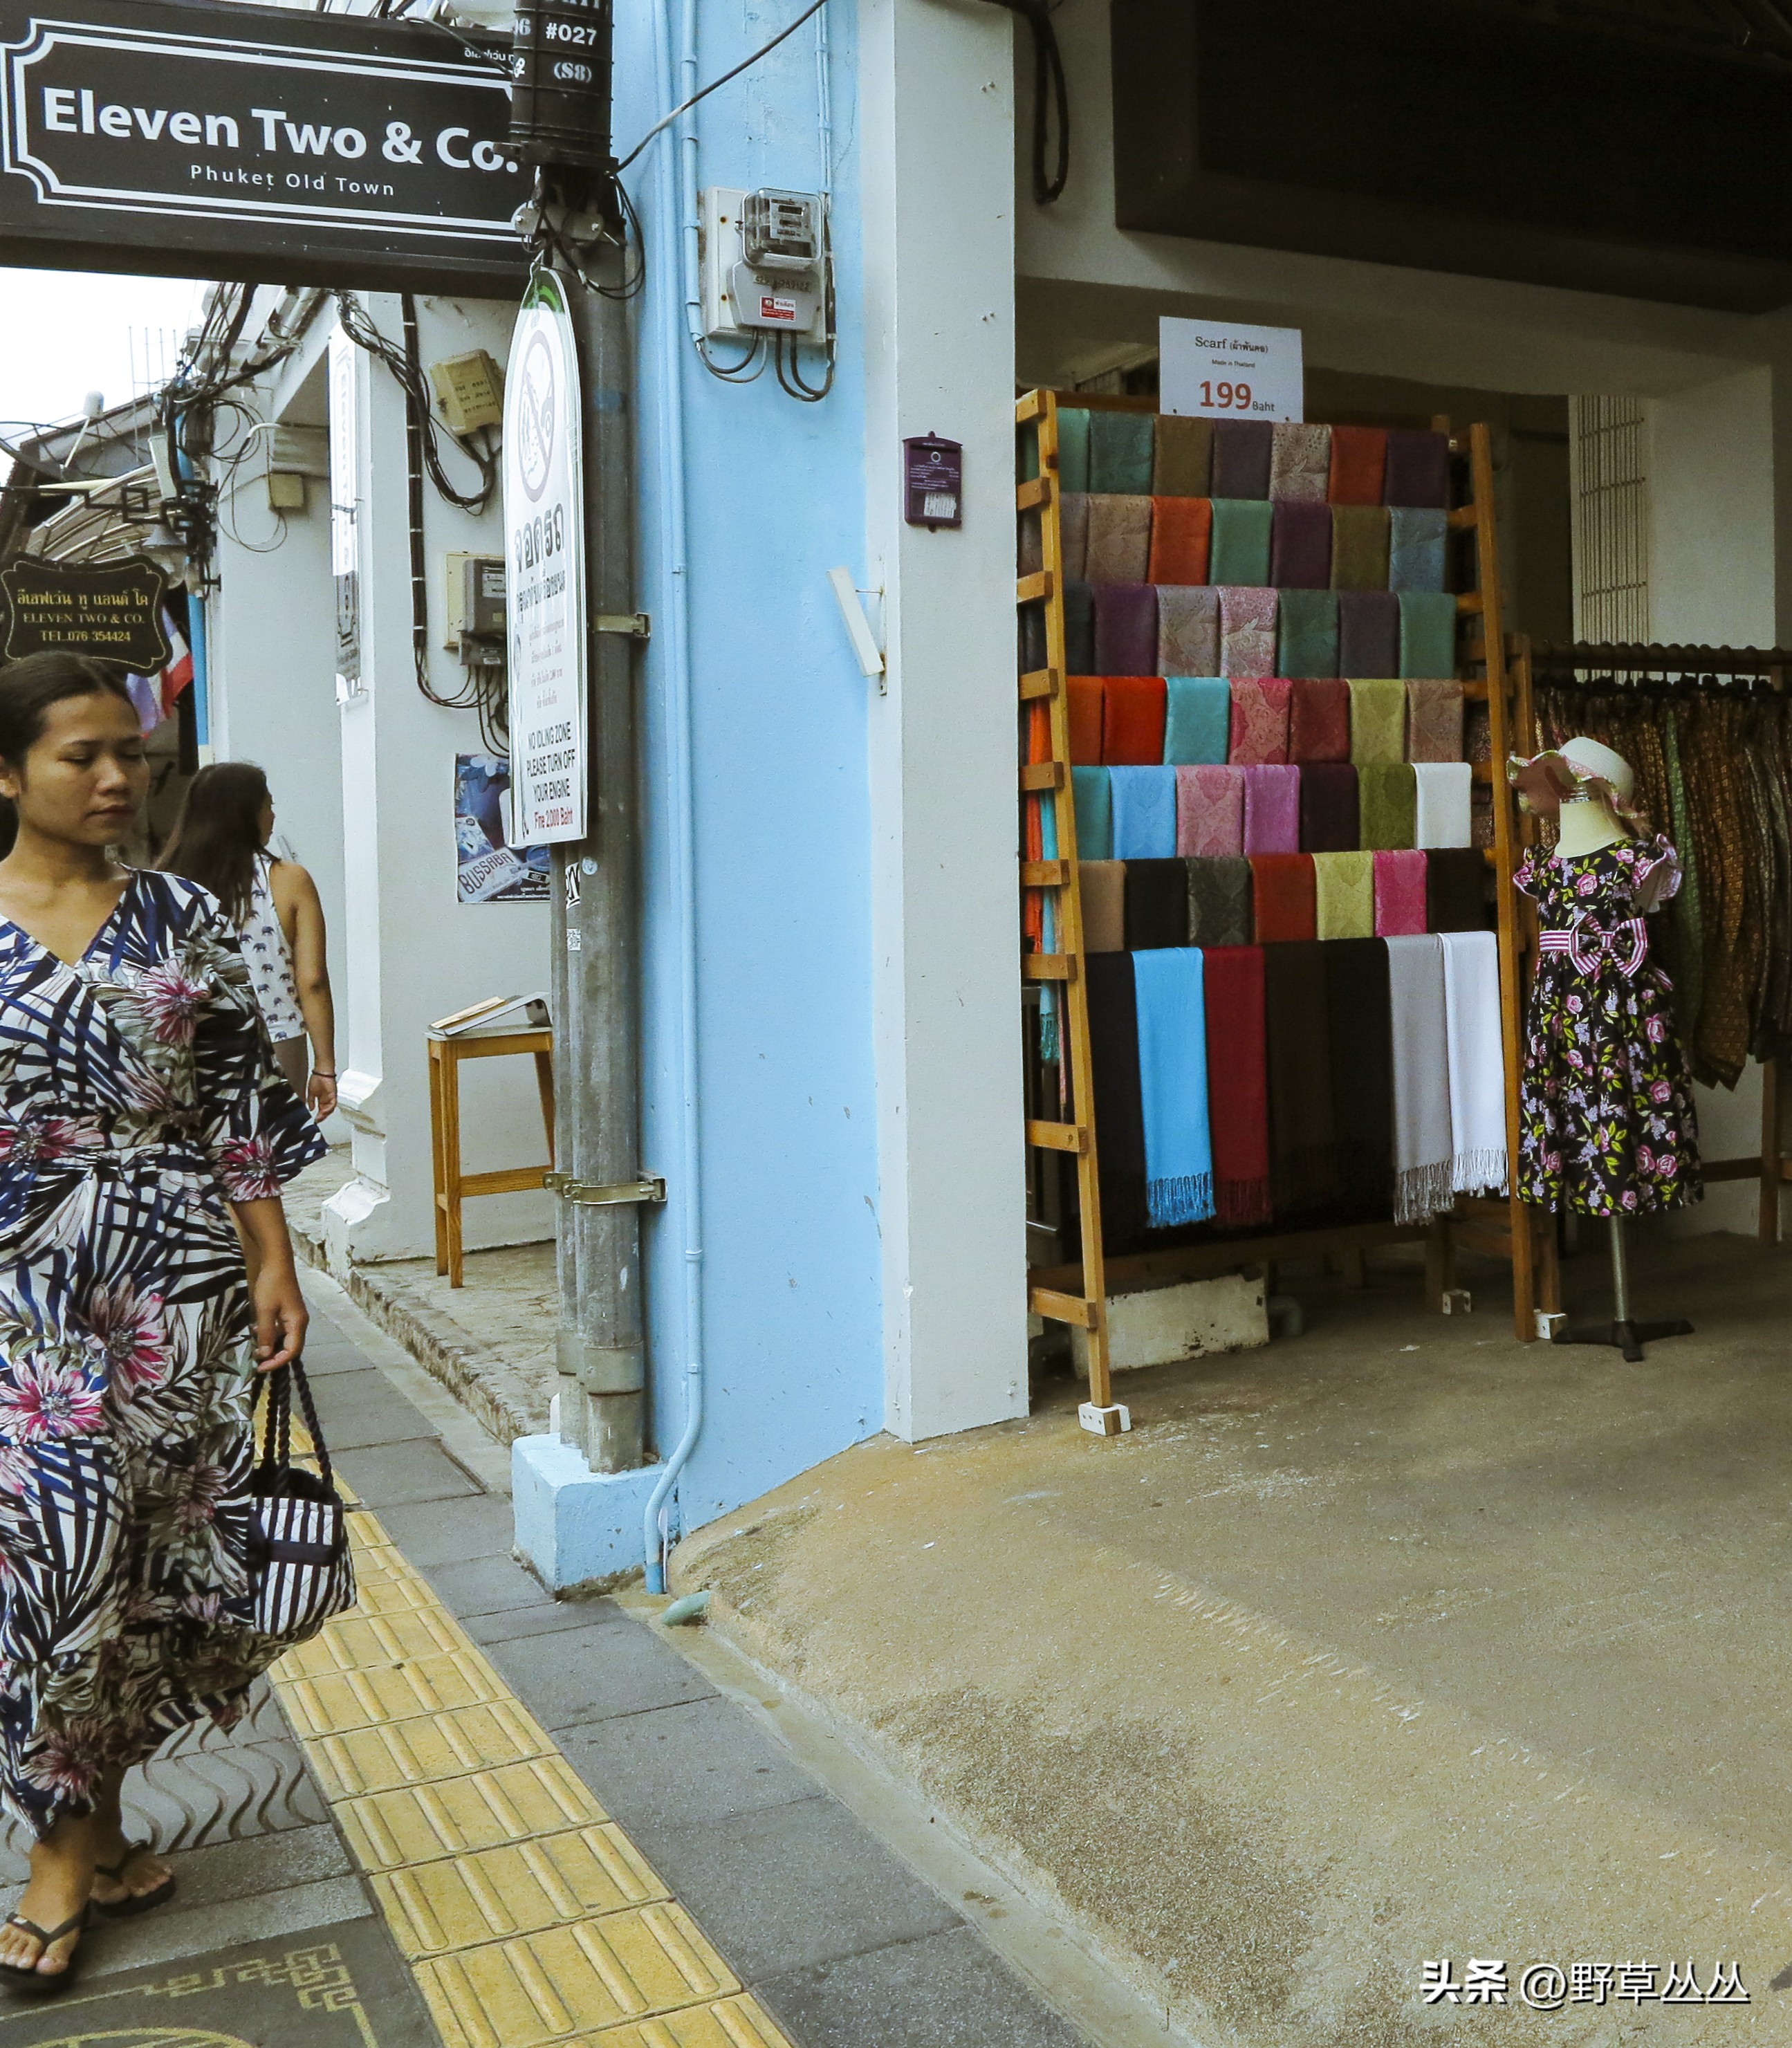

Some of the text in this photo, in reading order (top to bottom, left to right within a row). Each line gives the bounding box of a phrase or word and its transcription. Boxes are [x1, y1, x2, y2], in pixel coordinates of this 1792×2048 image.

[545, 22, 597, 46] #027
[553, 62, 592, 83] (S8)
[41, 86, 519, 173] Eleven Two & Co.
[190, 165, 394, 196] Phuket Old Town
[1194, 336, 1228, 349] Scarf
[1200, 380, 1275, 412] 199 Baht
[23, 613, 145, 624] ELEVEN TWO & CO.
[528, 721, 571, 750] NO IDLING ZONE
[526, 748, 575, 777] PLEASE TURN OFF
[533, 778, 570, 803] YOUR ENGINE
[458, 852, 514, 894] BUSSABA
